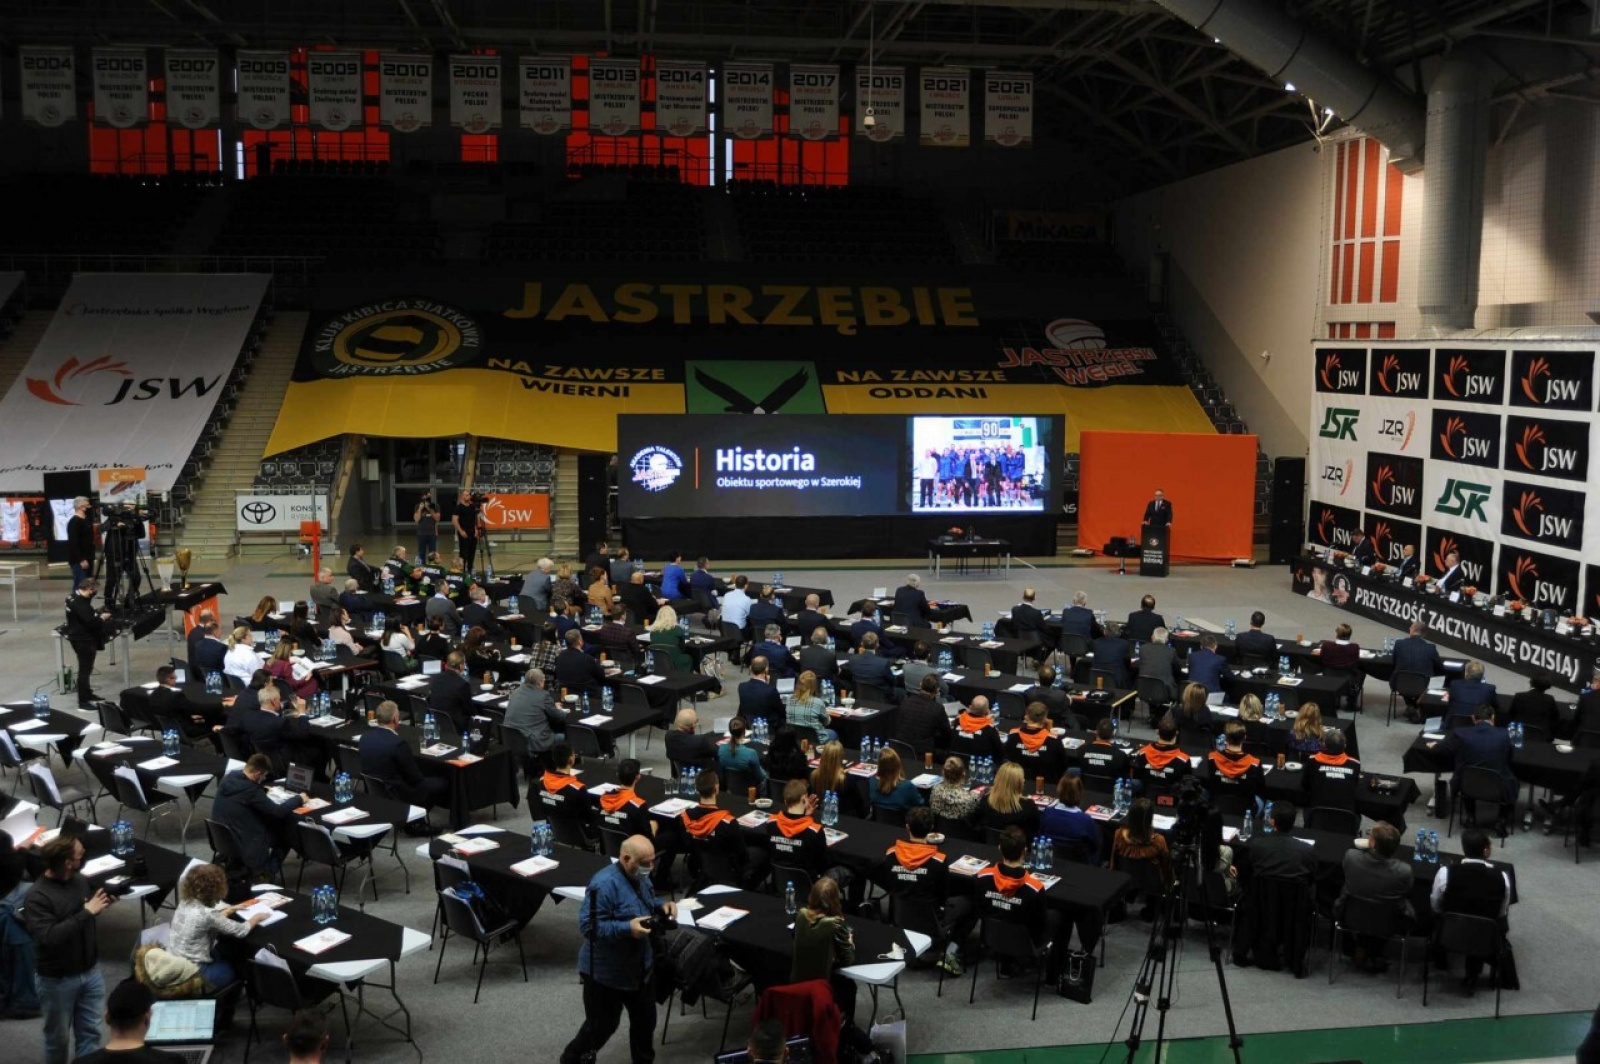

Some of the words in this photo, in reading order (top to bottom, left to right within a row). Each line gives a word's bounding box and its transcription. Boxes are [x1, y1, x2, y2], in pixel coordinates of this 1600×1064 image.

[23, 56, 71, 70] 2004
[96, 58, 144, 70] 2006
[168, 60, 215, 72] 2007
[240, 61, 287, 74] 2009
[311, 63, 357, 75] 2009
[384, 64, 429, 77] 2010
[453, 66, 498, 78] 2010
[526, 67, 564, 80] 2011
[593, 69, 636, 81] 2013
[659, 71, 703, 83] 2014
[727, 72, 770, 85] 2014
[793, 74, 836, 87] 2017
[860, 76, 901, 88] 2019
[924, 79, 966, 91] 2021
[988, 81, 1030, 94] 2021
[503, 281, 980, 336] JASTRZĘBIE
[315, 320, 345, 352] KLUB
[343, 300, 409, 322] KIBICA
[413, 300, 480, 347] SIATKÓWKI
[487, 358, 536, 374] NA
[544, 364, 665, 380] ZAWSZE
[836, 369, 884, 383] NA
[890, 369, 1008, 383] ZAWSZE
[519, 378, 630, 397] WIERNI
[1337, 370, 1360, 390] JSW
[1395, 372, 1421, 394] JSW
[1464, 374, 1496, 397] JSW
[104, 373, 224, 406] JSW
[868, 386, 988, 400] ODDANI
[1544, 379, 1581, 404] JSW
[982, 422, 998, 437] 90
[1319, 407, 1361, 442] JSK
[1378, 419, 1405, 436] JZR
[1461, 437, 1491, 459] JSW
[716, 446, 816, 472] Historia
[1540, 446, 1577, 471] JSW
[1321, 465, 1344, 482] JZR
[716, 476, 754, 488] Obiektu
[754, 477, 810, 490] sportowego
[811, 478, 820, 488] w
[820, 476, 862, 489] Szerokiej
[1389, 485, 1415, 506] JSW
[1434, 478, 1492, 523] JSK
[501, 509, 533, 525] JSW
[1537, 514, 1573, 539] JSW
[1459, 560, 1484, 582] SW
[1532, 579, 1567, 606] JSW
[1354, 586, 1426, 623] PRZYSZŁOŚĆ
[1428, 610, 1491, 649] ZACZYNA
[1494, 633, 1517, 664] SIĘ
[1519, 640, 1580, 684] DZISIAJ
